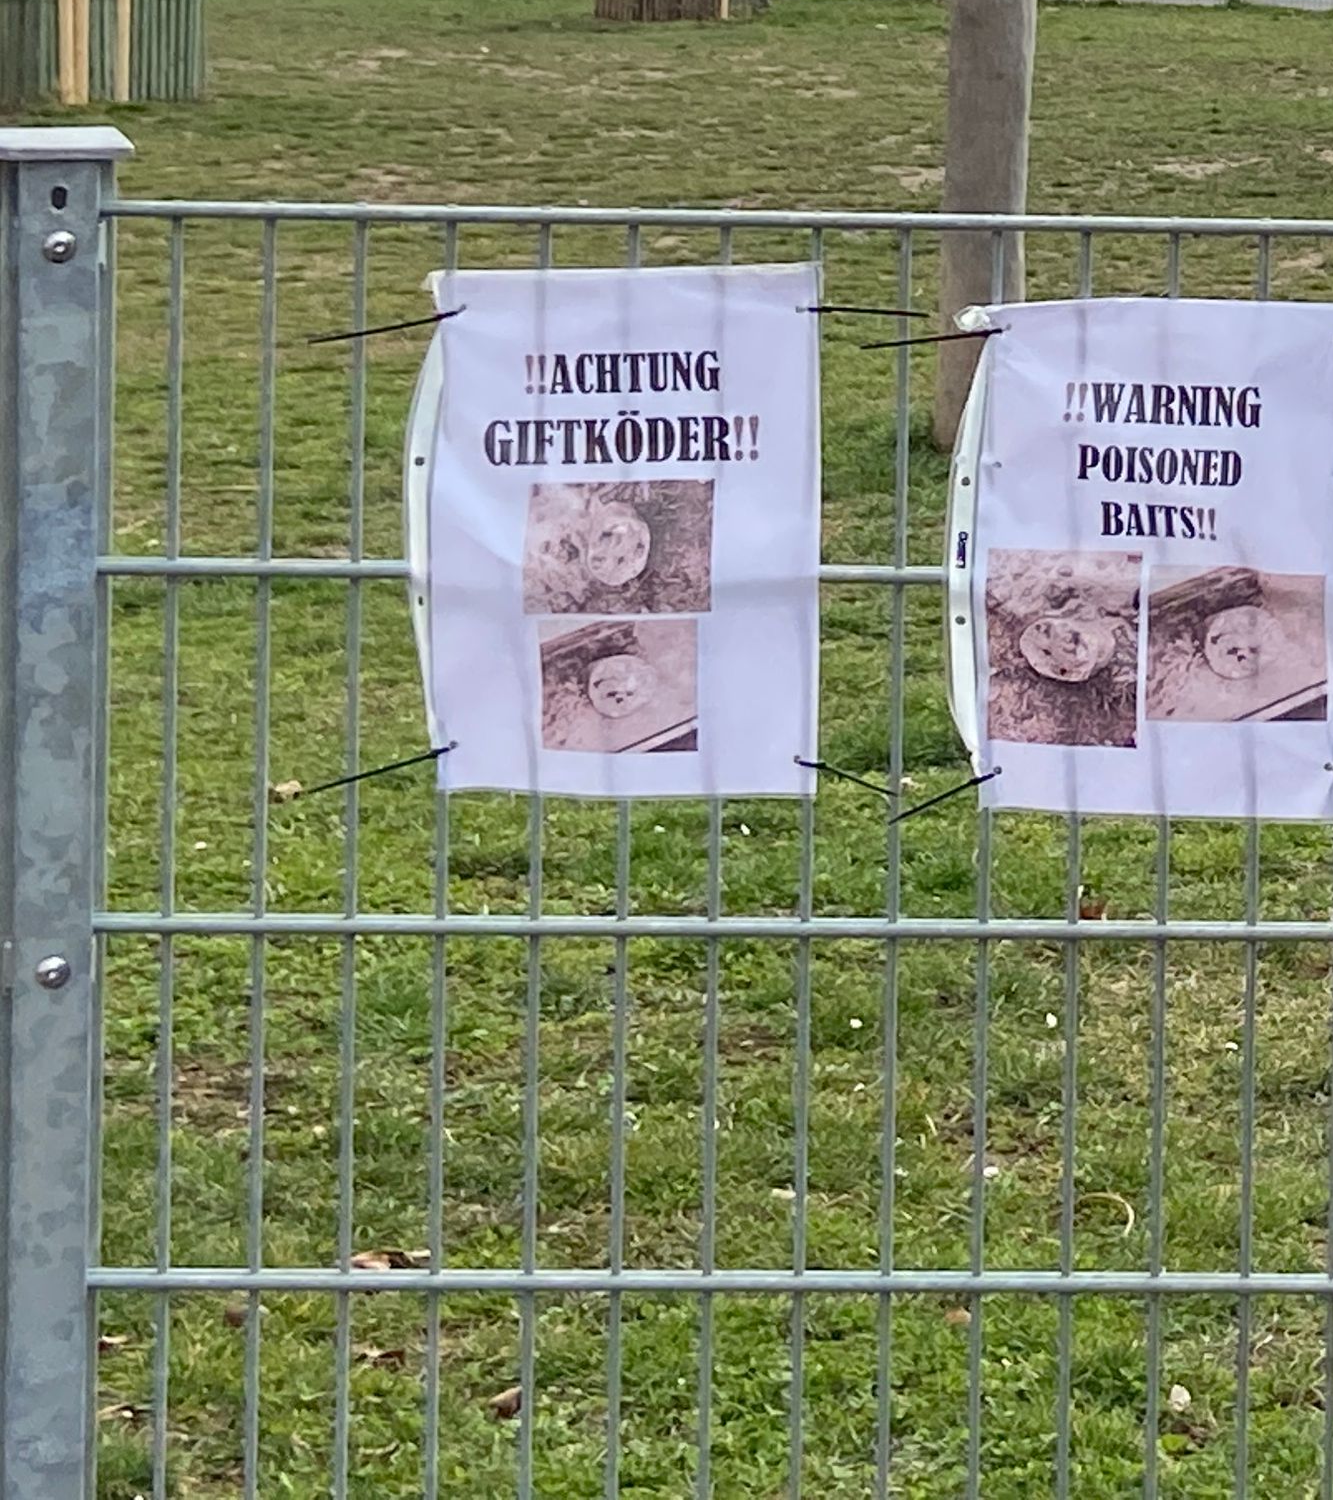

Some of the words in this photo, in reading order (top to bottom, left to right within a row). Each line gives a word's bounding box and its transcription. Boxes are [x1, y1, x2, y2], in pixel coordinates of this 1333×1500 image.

[525, 350, 720, 394] !!ACHTUNG
[1063, 381, 1261, 428] !!WARNING
[484, 410, 759, 466] GIFTKÖDER!!
[1078, 444, 1242, 487] POISONED
[1101, 501, 1217, 541] BAITS!!
